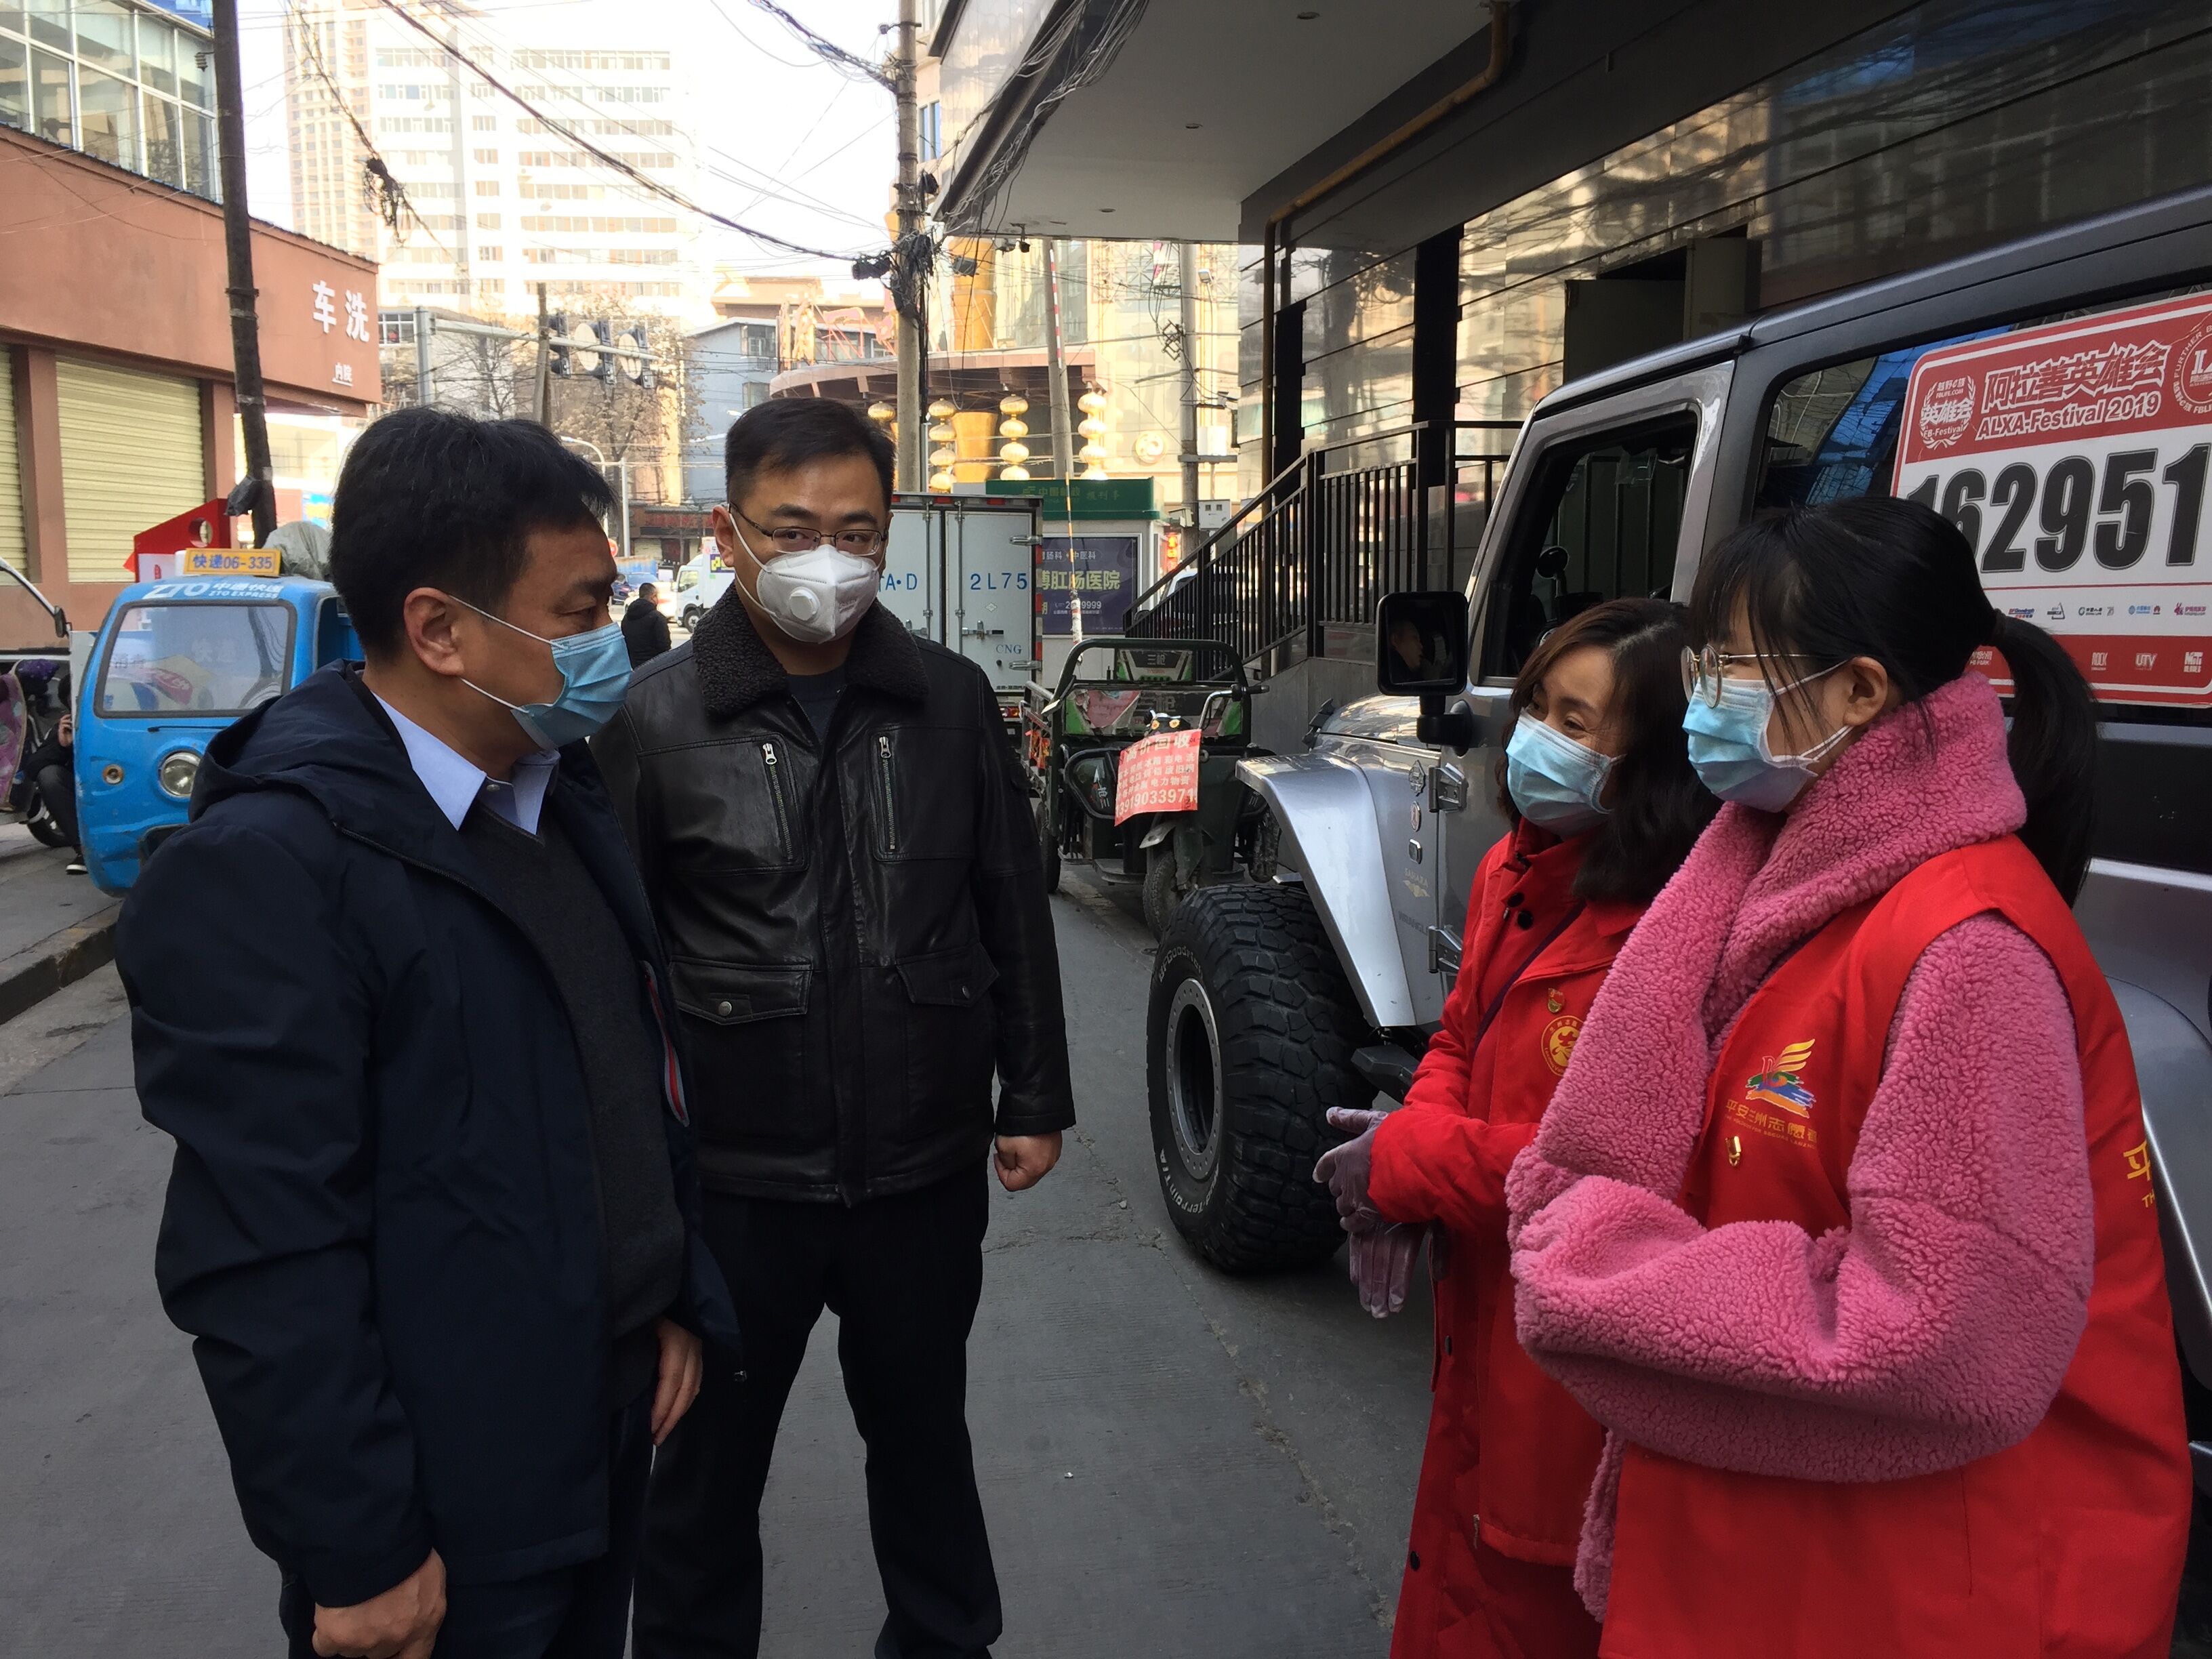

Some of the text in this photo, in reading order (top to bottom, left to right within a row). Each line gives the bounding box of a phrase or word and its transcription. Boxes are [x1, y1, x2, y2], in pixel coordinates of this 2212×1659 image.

[1981, 342, 2171, 414] 阿拉善英雄会
[1923, 398, 1974, 426] 英雄会
[2106, 391, 2163, 422] 2019
[142, 583, 210, 599] ZTO
[996, 644, 1022, 655] CNG
